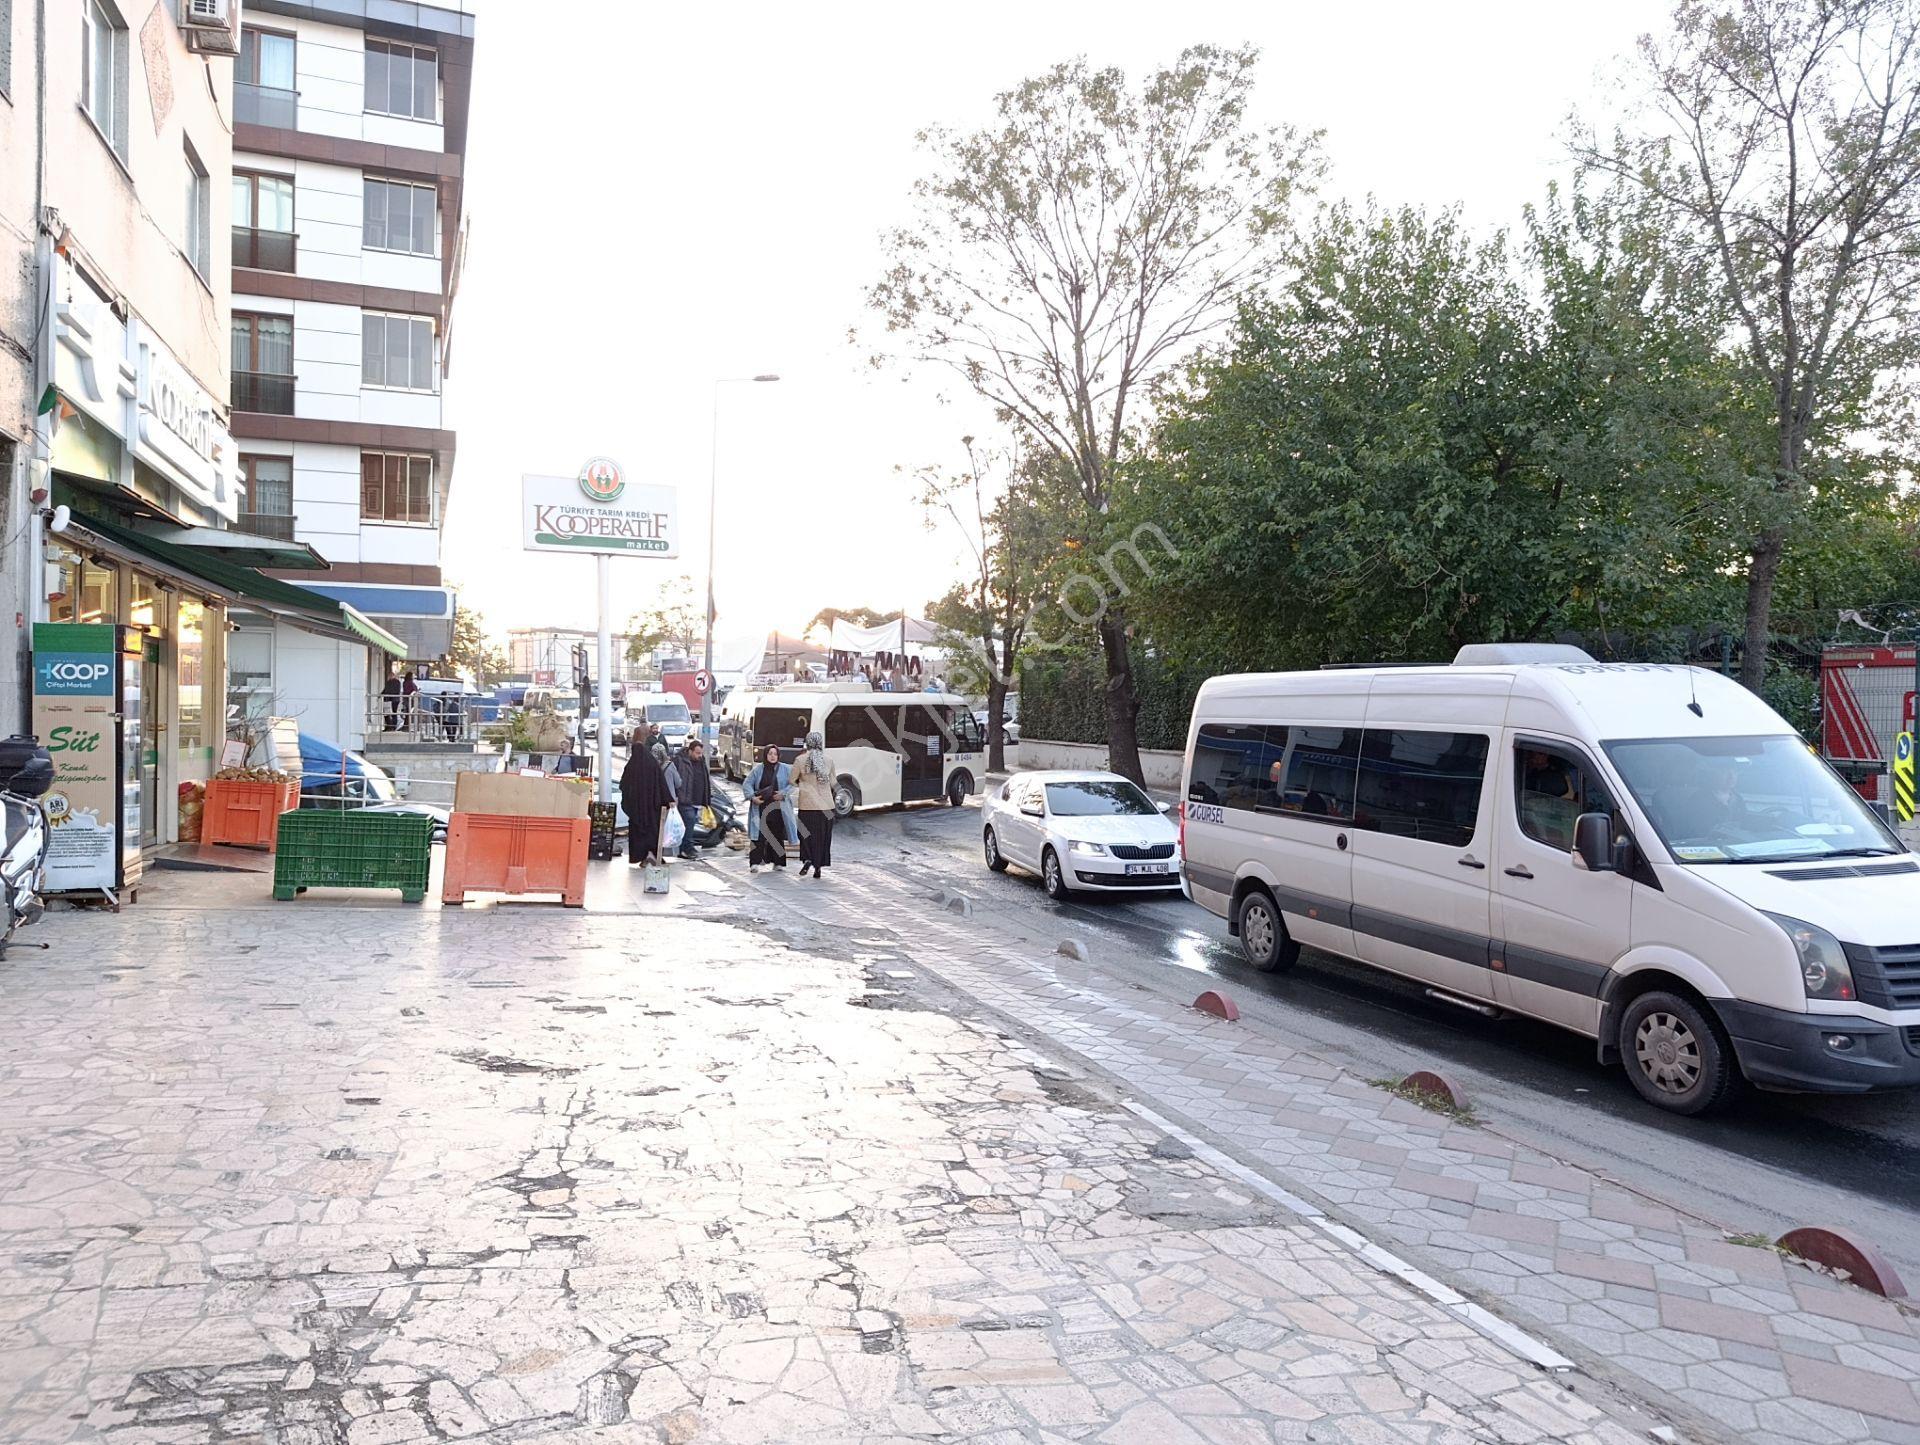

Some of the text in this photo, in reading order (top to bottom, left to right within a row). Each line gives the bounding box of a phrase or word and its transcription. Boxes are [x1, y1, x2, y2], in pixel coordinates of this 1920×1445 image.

[560, 505, 650, 519] TÜRKİYE TARIM KREDİ
[534, 504, 668, 539] KOOPERATİF
[626, 540, 665, 550] market
[47, 726, 100, 752] Süt
[59, 763, 89, 771] Kendi
[1130, 865, 1138, 873] 34
